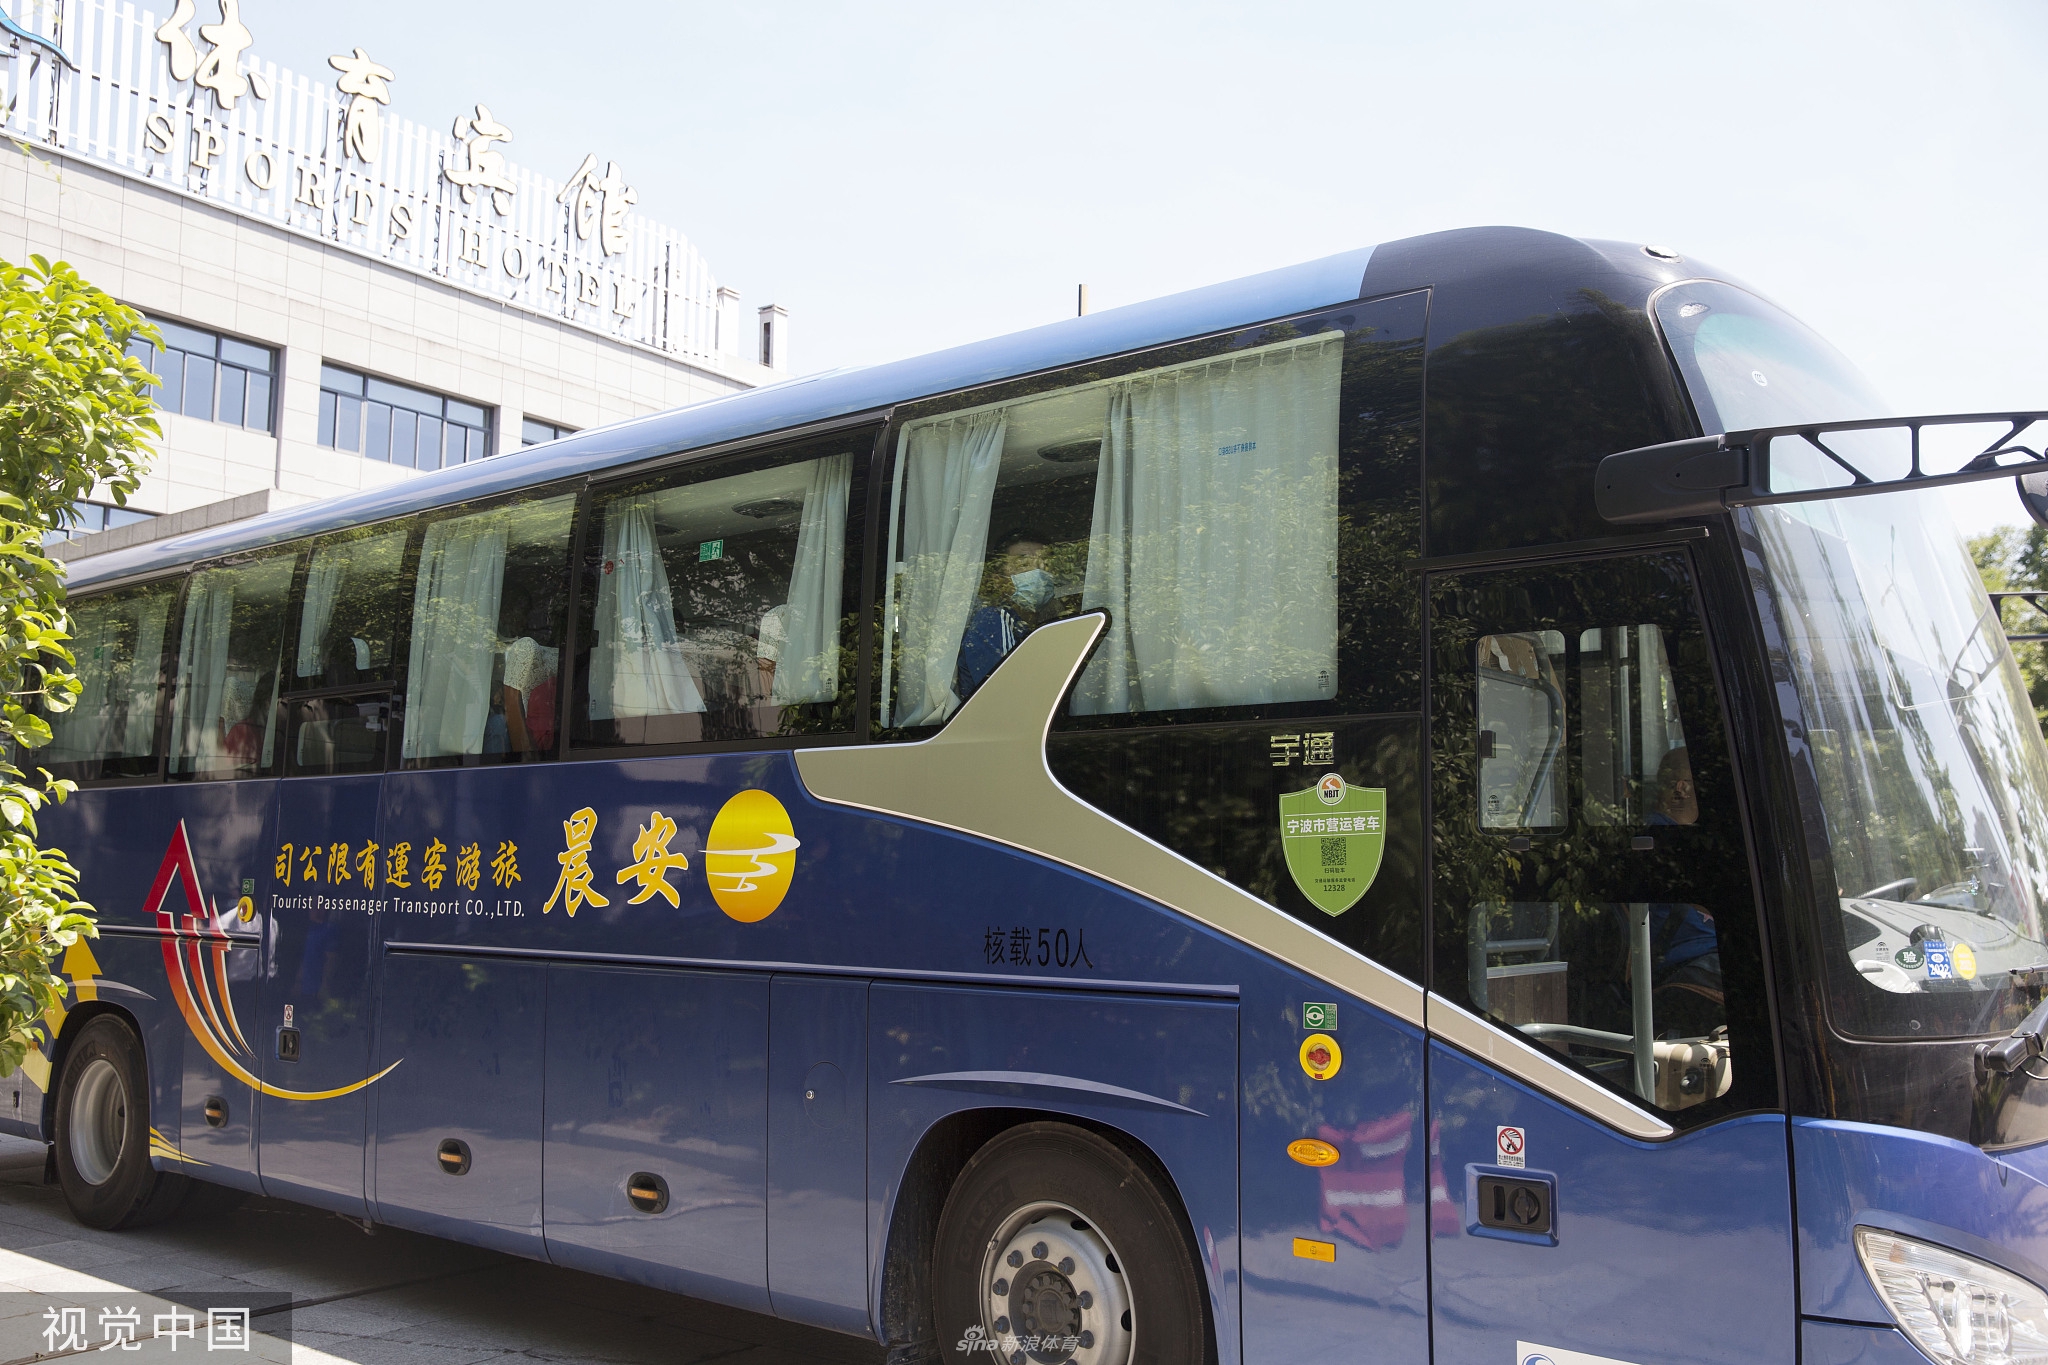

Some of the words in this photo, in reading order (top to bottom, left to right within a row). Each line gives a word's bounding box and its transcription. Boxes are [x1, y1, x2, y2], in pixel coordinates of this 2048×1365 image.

[156, 0, 638, 257] 体育宾馆
[144, 112, 416, 239] SPORTS
[459, 227, 637, 318] HOTEL
[1270, 732, 1335, 767] 宇通
[1323, 789, 1340, 799] NBJT
[1287, 815, 1380, 834] 宁波市营运客车
[1323, 884, 1346, 892] 12328
[272, 894, 313, 910] Tourist
[317, 895, 388, 916] Passenager
[393, 897, 460, 919] Transport
[465, 899, 525, 919] CO.,LTD.
[984, 926, 1093, 969] 核载50人
[1902, 951, 1917, 963] 验
